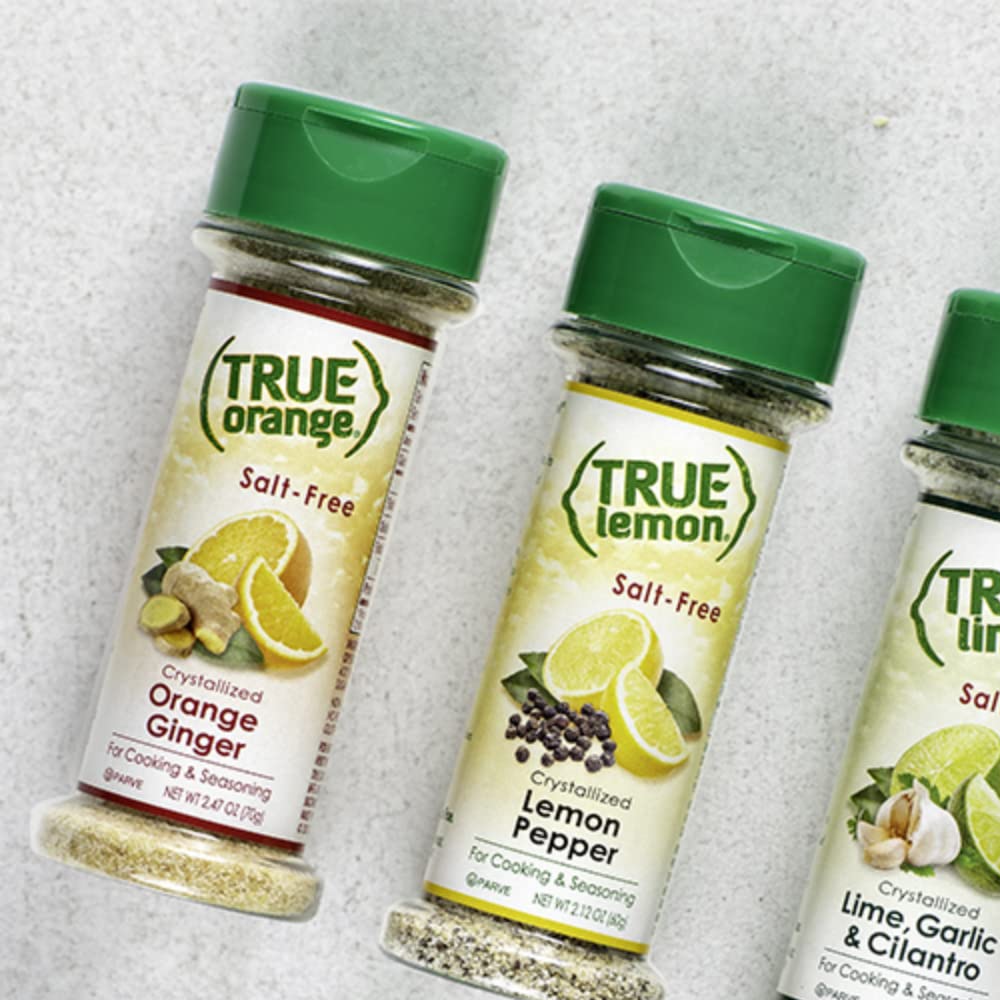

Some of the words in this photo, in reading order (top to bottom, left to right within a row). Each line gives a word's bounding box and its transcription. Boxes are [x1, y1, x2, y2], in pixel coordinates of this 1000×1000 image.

[223, 354, 359, 404] TRUE
[223, 405, 355, 449] orange
[239, 467, 356, 517] Salt-Free
[591, 459, 730, 509] TRUE
[596, 506, 725, 543] lemon
[611, 573, 722, 623] Salt-Free
[149, 683, 258, 732] Orange
[161, 664, 264, 704] Crystallized
[146, 713, 247, 760] Ginger
[107, 741, 124, 759] For
[124, 747, 182, 779] Cooking
[185, 766, 195, 781] &
[199, 768, 273, 804] Seasoning
[530, 770, 633, 811] Crystallized
[163, 786, 184, 802] NET
[185, 790, 201, 806] WT
[201, 795, 223, 813] 2.47
[223, 801, 241, 818] OZ
[521, 789, 621, 838] Lemon
[512, 816, 619, 865] Pepper
[468, 846, 489, 863] For
[489, 853, 551, 886] Cooking
[555, 872, 566, 887] &
[569, 875, 637, 909] Seasoning
[477, 878, 513, 897] PARVE
[532, 892, 553, 908] NET
[553, 897, 570, 912] WT
[570, 901, 593, 918] 2.12
[593, 907, 607, 923] OZ
[878, 880, 981, 921] Crystallized
[841, 890, 910, 935] Lime,
[915, 914, 999, 955] Garlic
[818, 956, 838, 973] For
[839, 963, 899, 996] Cooking
[902, 982, 914, 998] &
[844, 925, 862, 949] &
[867, 931, 981, 982] Cilantro
